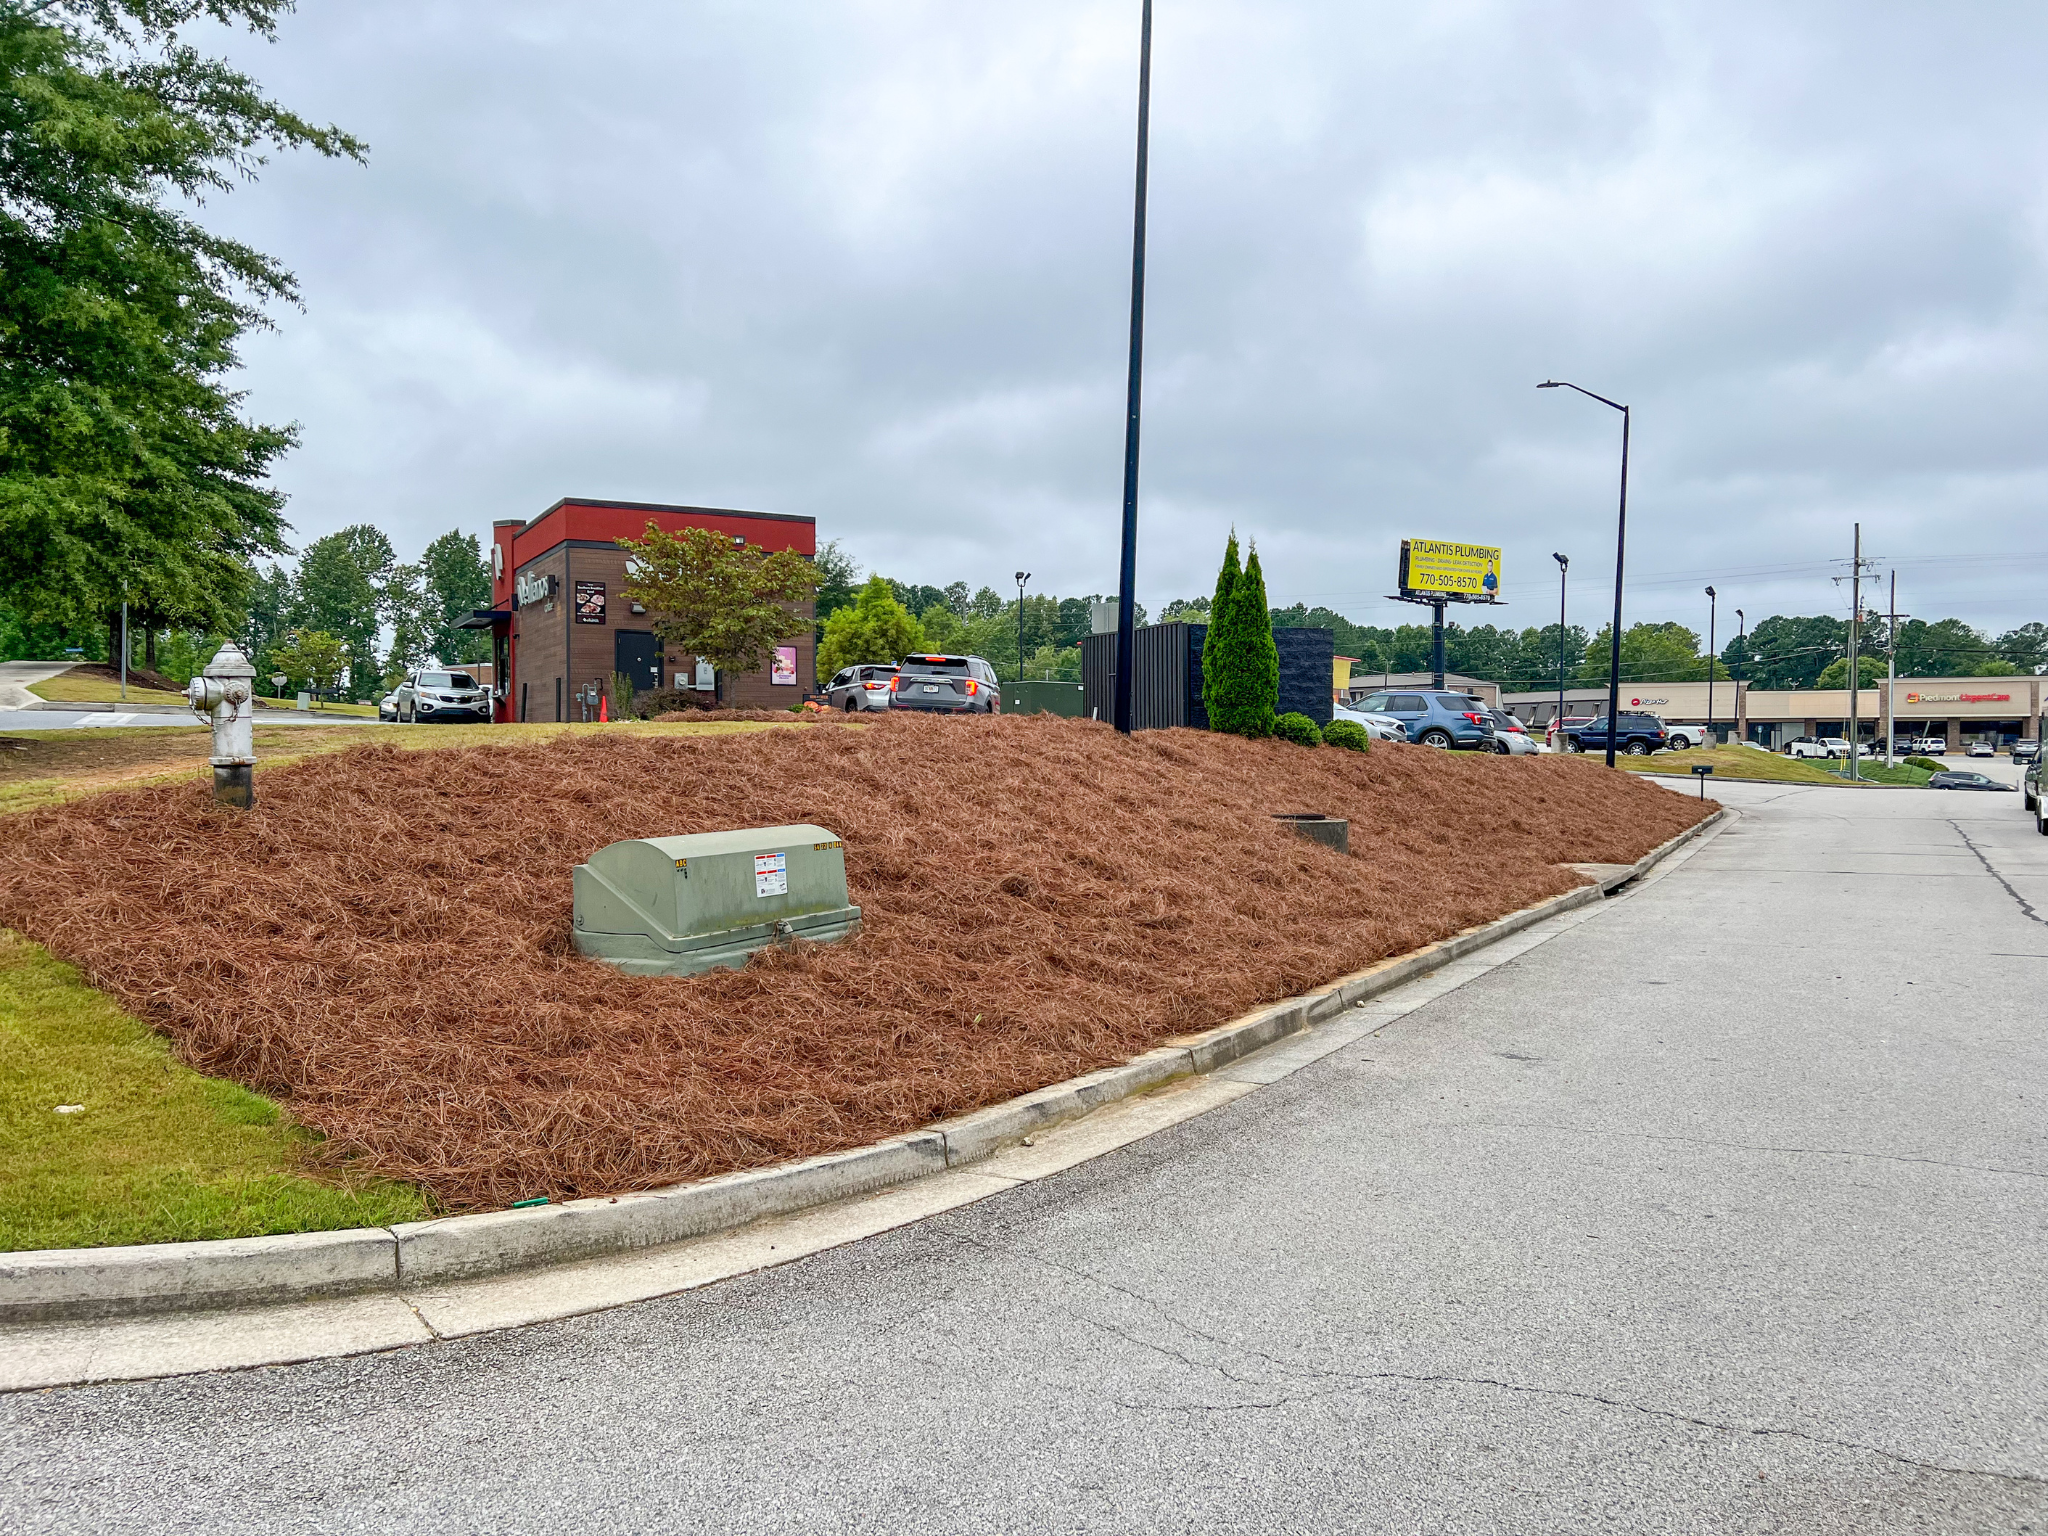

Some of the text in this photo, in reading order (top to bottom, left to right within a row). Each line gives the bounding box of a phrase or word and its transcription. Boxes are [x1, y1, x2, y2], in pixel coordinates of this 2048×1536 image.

[1413, 541, 1499, 560] ATLANTIS PLUMBING
[1463, 560, 1483, 568] DETECTION
[1420, 573, 1478, 588] 770-505-8570
[1919, 693, 1960, 702] Piedmont
[675, 858, 687, 868] ABC
